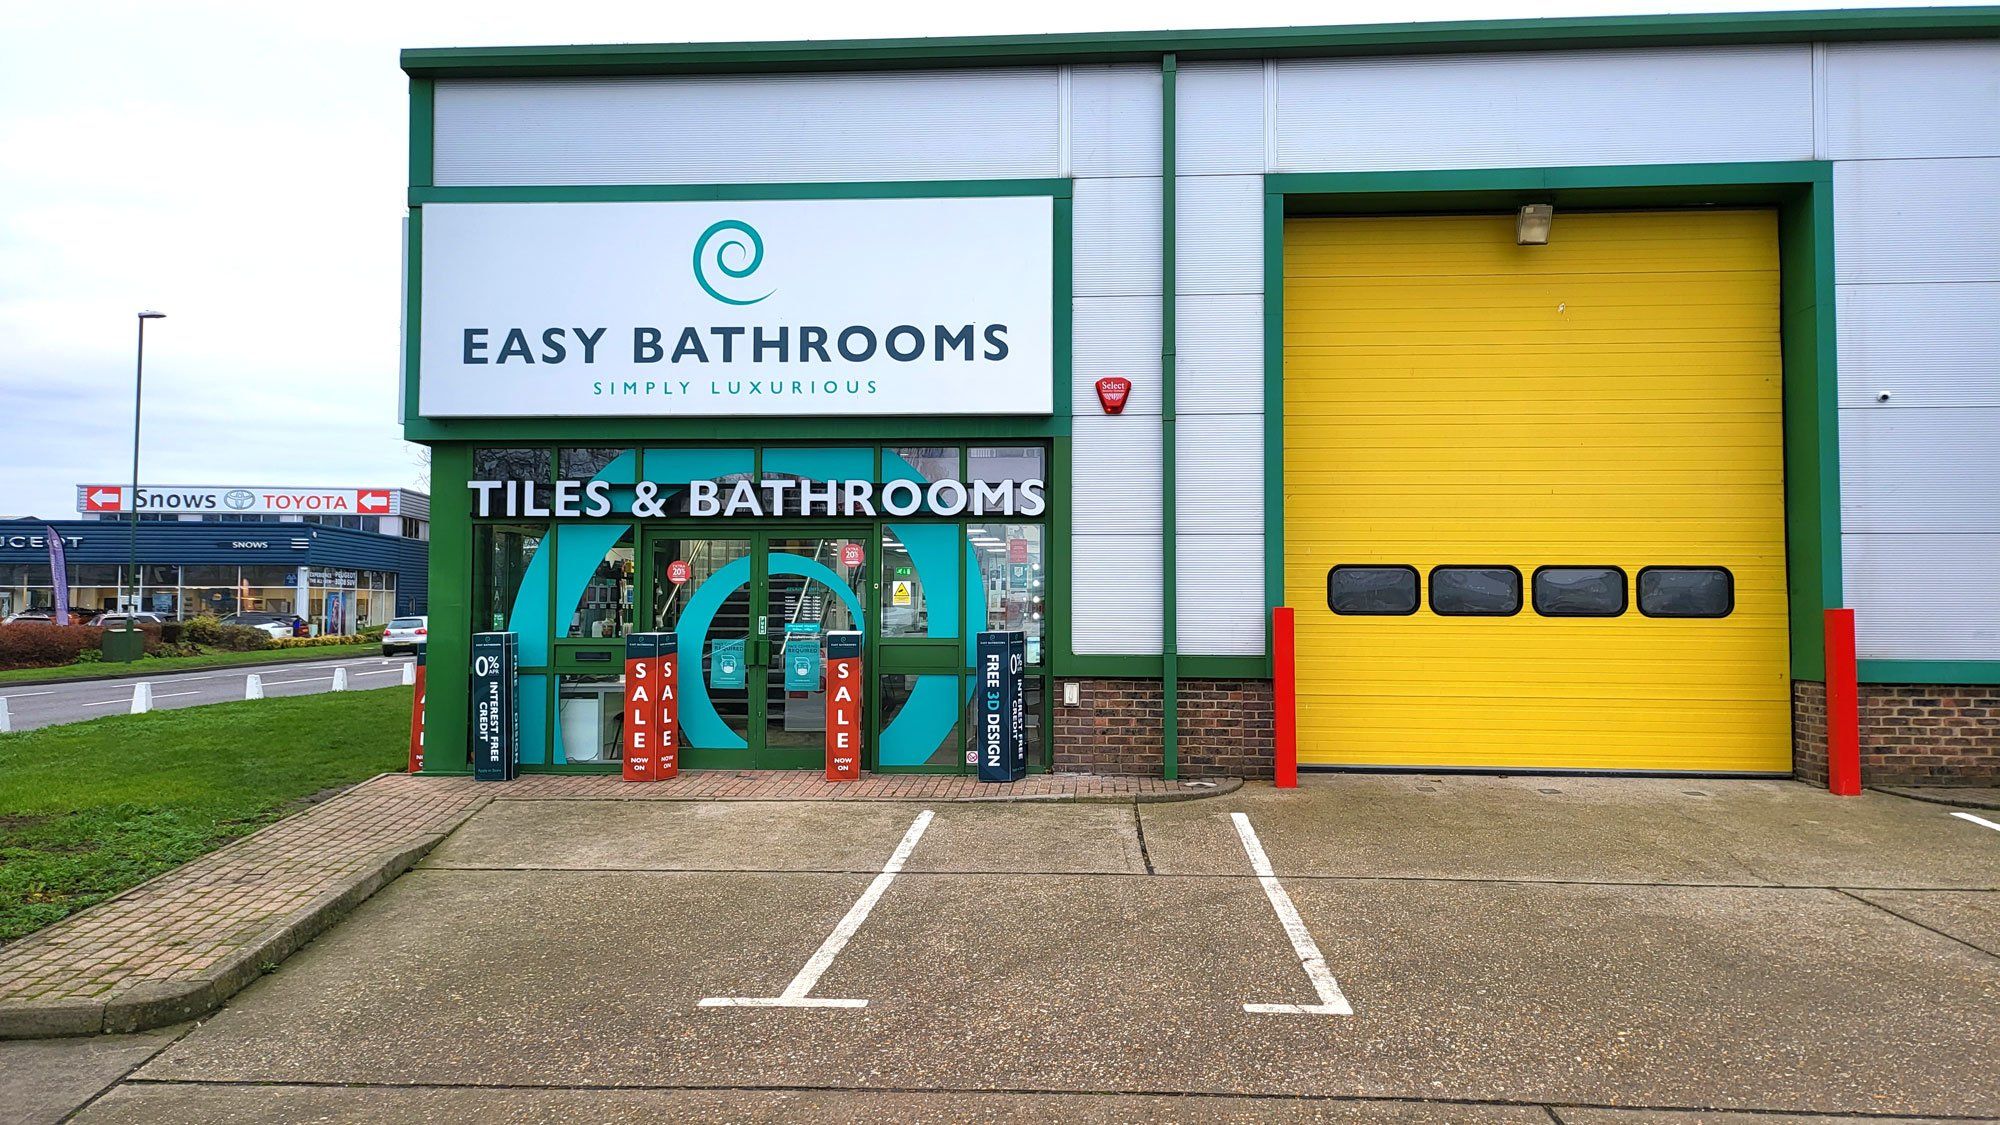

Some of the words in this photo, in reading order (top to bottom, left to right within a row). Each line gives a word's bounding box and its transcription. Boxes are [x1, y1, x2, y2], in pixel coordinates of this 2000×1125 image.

[463, 328, 607, 364] EASY
[633, 324, 1010, 364] BATHROOMS
[593, 382, 691, 395] SIMPLY
[711, 380, 877, 394] LUXURIOUS
[1102, 381, 1125, 390] Select
[136, 489, 216, 509] Snows
[263, 494, 348, 510] TOYOTA
[467, 480, 611, 518] TILES
[631, 480, 667, 518] &
[689, 479, 1046, 518] BATHROOMS
[232, 541, 269, 549] SNOWS
[475, 655, 500, 677] 0%
[986, 654, 1000, 688] FREE
[490, 681, 499, 734] INTEREST
[632, 662, 649, 748] SALE
[662, 661, 674, 747] SALE
[834, 662, 852, 749] SALE
[987, 691, 1000, 711] 3D
[479, 701, 489, 742] CREDIT
[491, 736, 500, 762] FREE
[987, 713, 1001, 767] DESIGN
